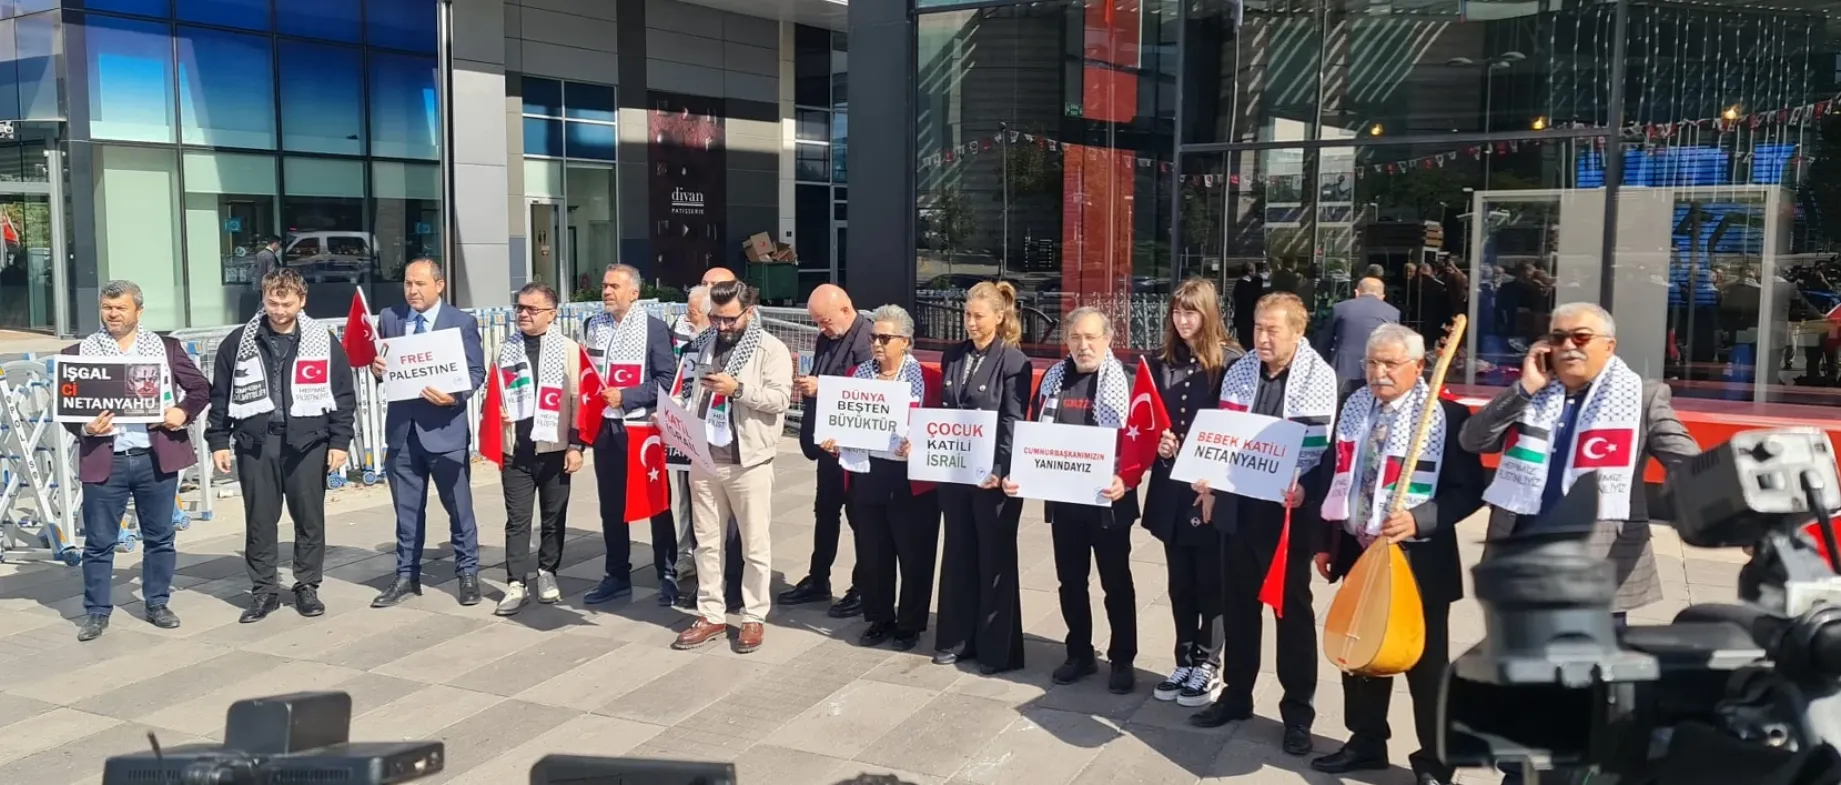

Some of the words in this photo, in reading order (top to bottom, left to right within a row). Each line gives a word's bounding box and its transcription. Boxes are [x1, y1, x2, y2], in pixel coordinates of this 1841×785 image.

[671, 187, 704, 202] divan
[400, 351, 433, 364] FREE
[62, 363, 111, 381] İŞGAL
[389, 362, 458, 381] PALESTINE
[63, 397, 155, 410] NETANYAHU
[842, 390, 886, 403] DÜNYA
[837, 401, 890, 414] BEŞTEN
[829, 412, 897, 432] BÜYÜKTÜR
[926, 422, 983, 438] ÇOCUK
[927, 439, 971, 452] KATİLİ
[1197, 431, 1239, 448] BEBEK
[1243, 438, 1287, 458] KATİLİ
[926, 452, 967, 468] İSRAİL
[1023, 446, 1105, 461] CUMHURBAŞKANIMIZIN
[1194, 445, 1280, 474] NETANYAHU
[1034, 458, 1092, 473] YANINDAYIZ
